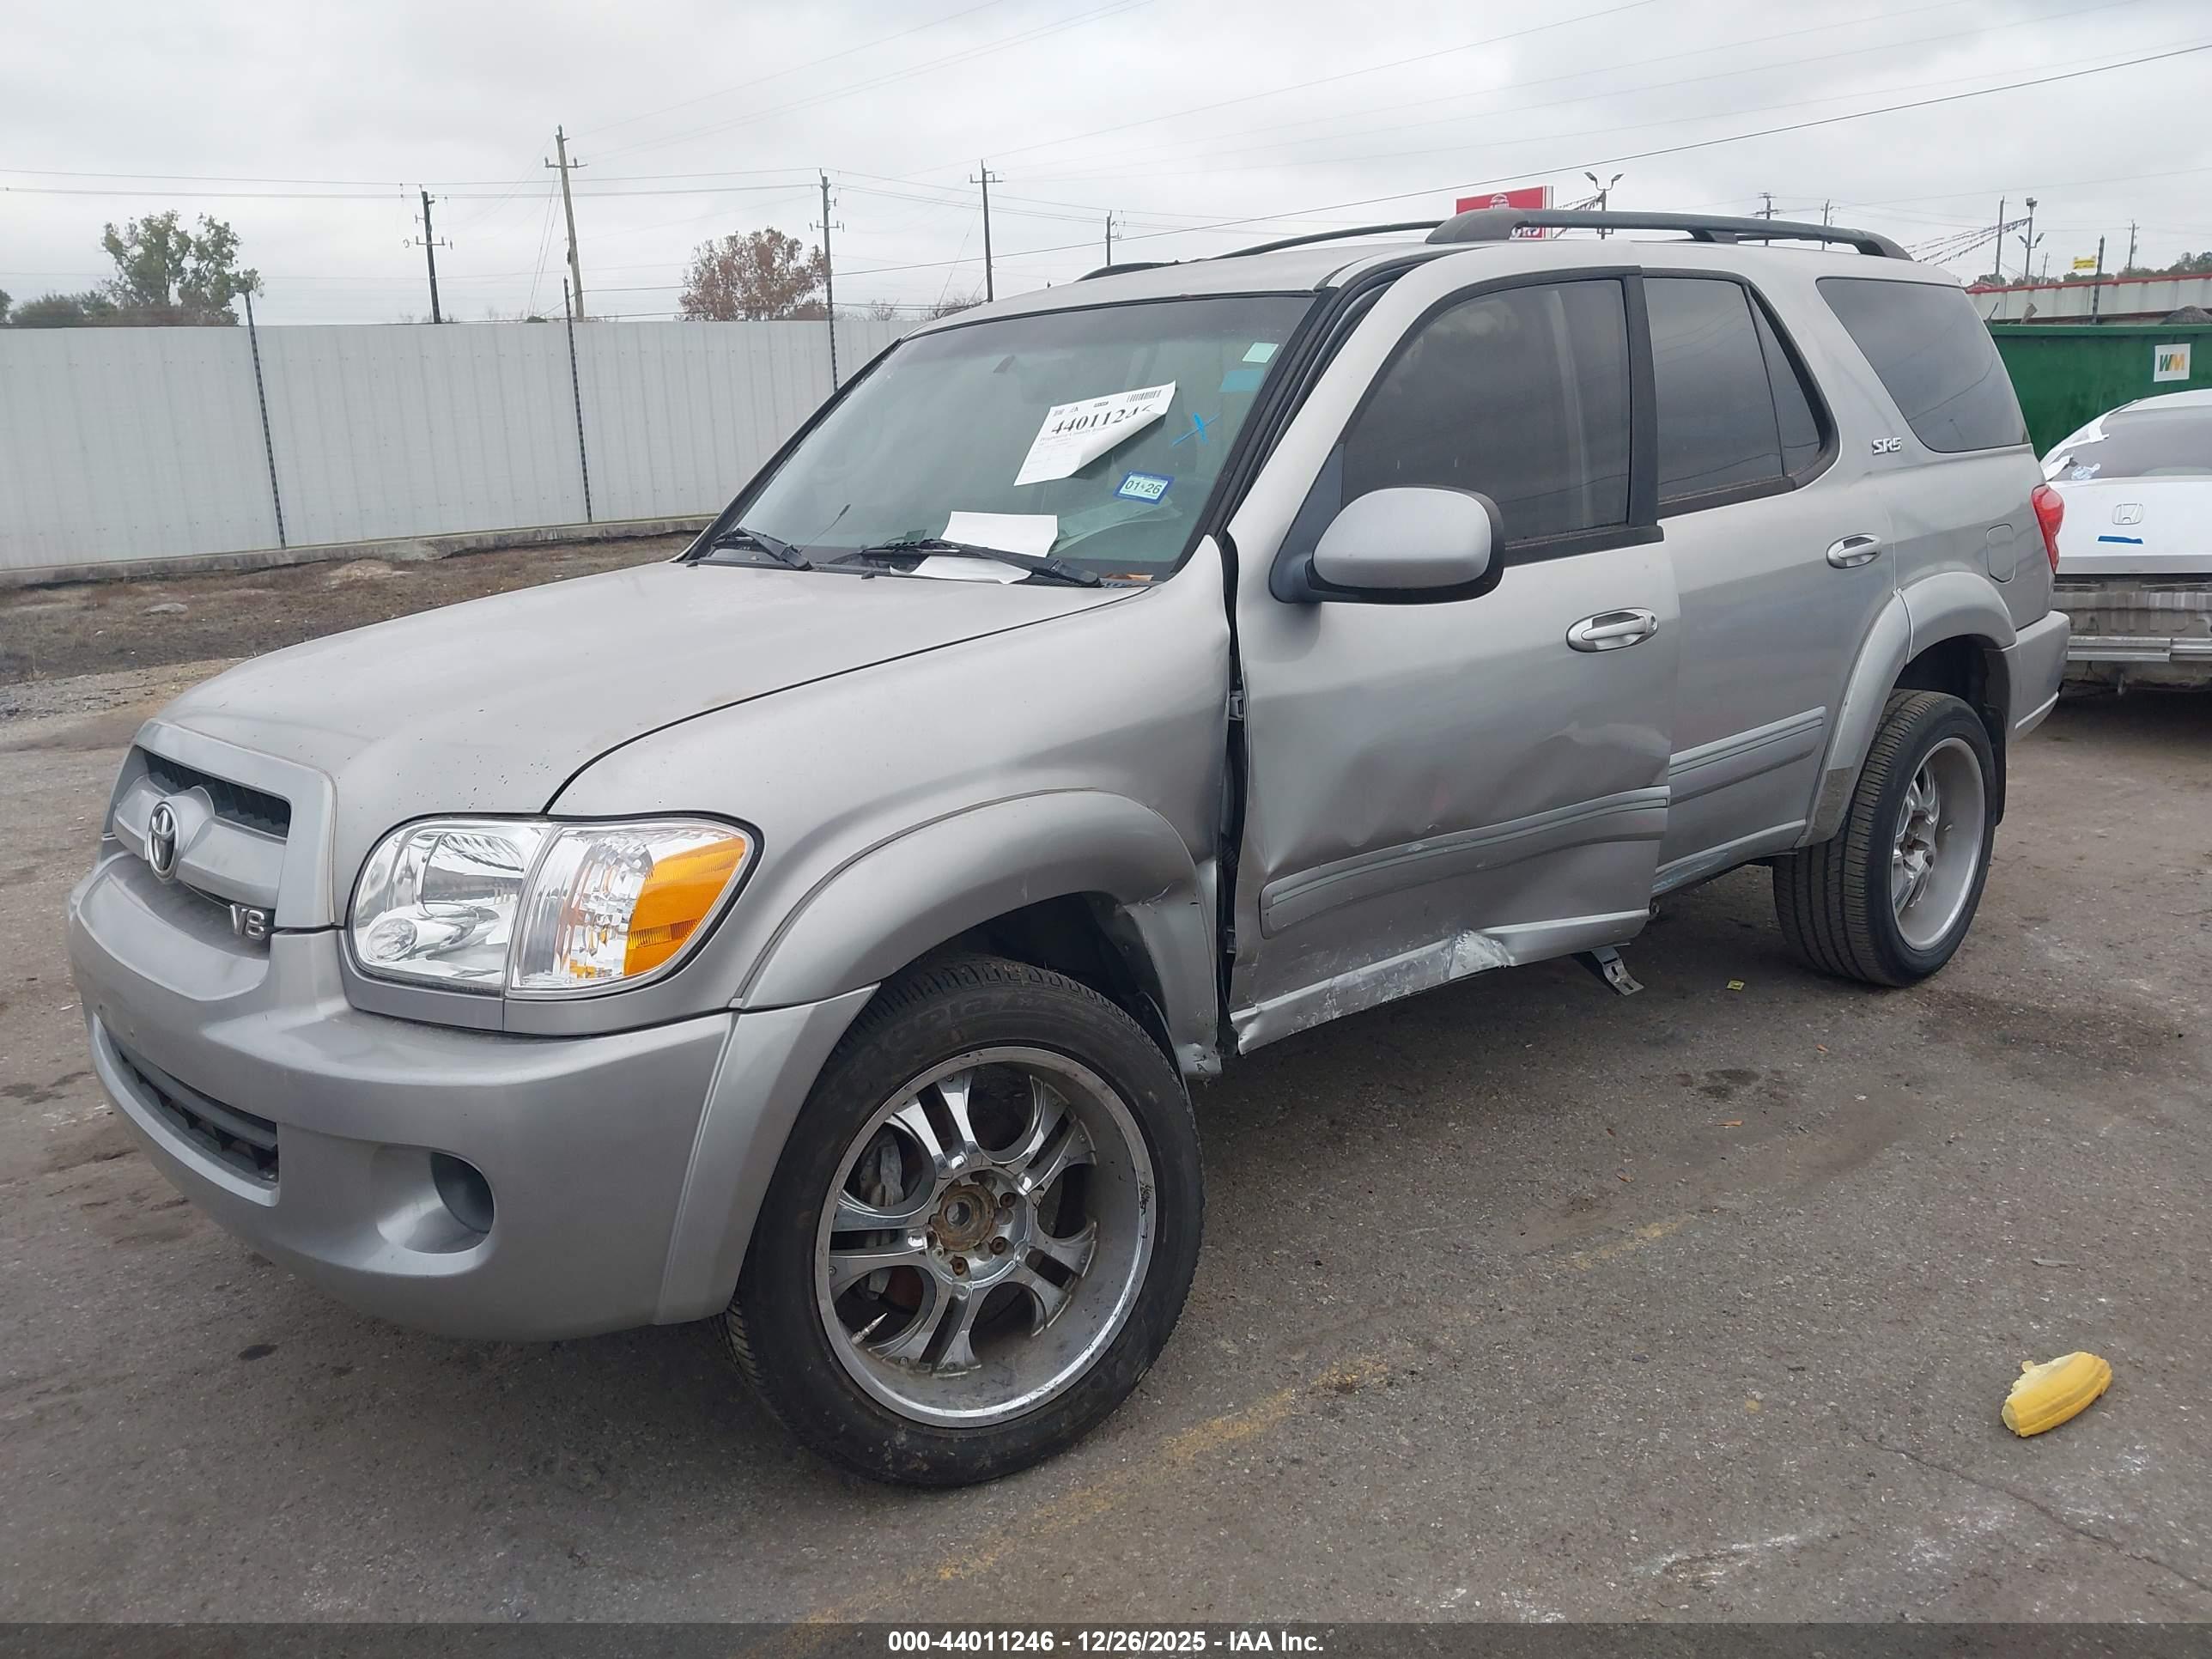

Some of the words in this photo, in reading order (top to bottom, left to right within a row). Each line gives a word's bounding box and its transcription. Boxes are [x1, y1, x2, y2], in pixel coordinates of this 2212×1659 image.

[2159, 353, 2185, 372] WM
[1872, 436, 1902, 455] SR5
[229, 903, 265, 941] V8
